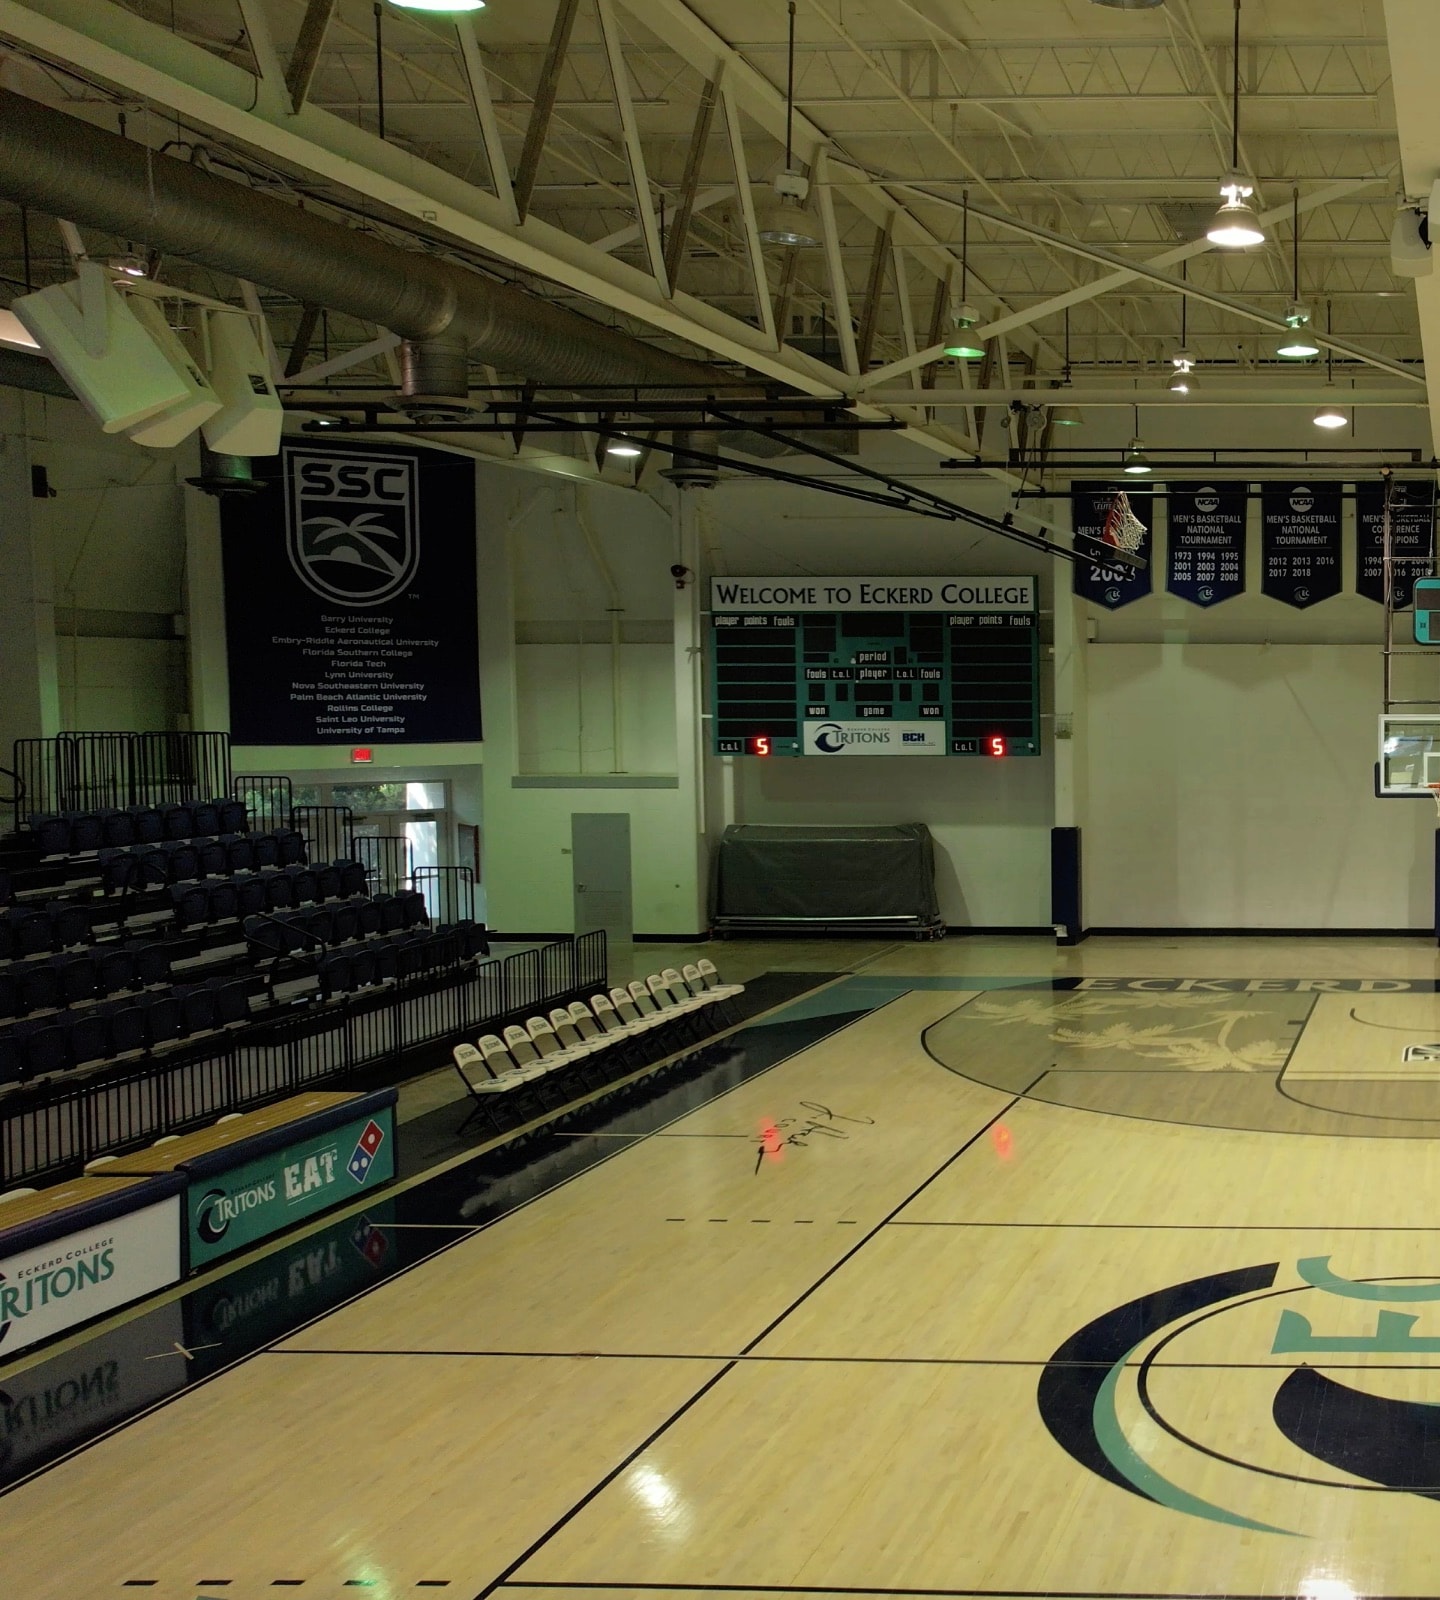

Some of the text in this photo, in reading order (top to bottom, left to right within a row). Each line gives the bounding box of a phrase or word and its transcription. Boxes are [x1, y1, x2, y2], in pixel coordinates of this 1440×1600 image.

[301, 463, 405, 500] SSC
[1173, 515, 1241, 523] MEN'S BASKETBALL
[1267, 515, 1336, 523] MEN'S BASKETBALL
[1187, 526, 1224, 534] NATIONAL
[1282, 526, 1320, 534] NATIONAL
[1181, 536, 1232, 544] TOURNAMENT
[1276, 536, 1327, 544] TOURNAMENT
[1175, 552, 1238, 560] 1973 1994 1995
[1269, 557, 1334, 565] 2012 2013 2016
[1197, 563, 1215, 571] 2003
[1220, 563, 1238, 571] 2004
[1197, 573, 1215, 581] 2007
[1269, 569, 1311, 577] 2017 2018
[321, 615, 393, 625] Barry University
[715, 616, 795, 626] player points fouls
[950, 615, 1031, 626] player points fouls
[358, 627, 390, 635] College
[272, 636, 439, 648] Embry-Riddle Aeronautical University
[337, 649, 378, 657] Southern
[381, 649, 413, 658] College
[859, 652, 887, 662] period
[366, 660, 386, 668] Tech
[325, 671, 393, 680] Lynn University
[806, 668, 826, 679] fouls
[859, 668, 887, 680] player
[920, 668, 940, 679] fouls
[318, 682, 378, 690] Southeastern
[380, 682, 424, 691] University
[291, 693, 427, 702] Palm Beach Atlantic University
[328, 704, 393, 713] Rollins College
[809, 706, 939, 716] won game won
[316, 715, 405, 724] Saint Leo University
[317, 726, 405, 735] University of Tampa
[833, 730, 890, 744] TRITONS
[1080, 977, 1412, 993] ECKERD
[215, 1180, 276, 1222] TRITONS
[284, 1149, 338, 1200] EAT
[18, 1238, 114, 1279] ECKERD COLLEGE
